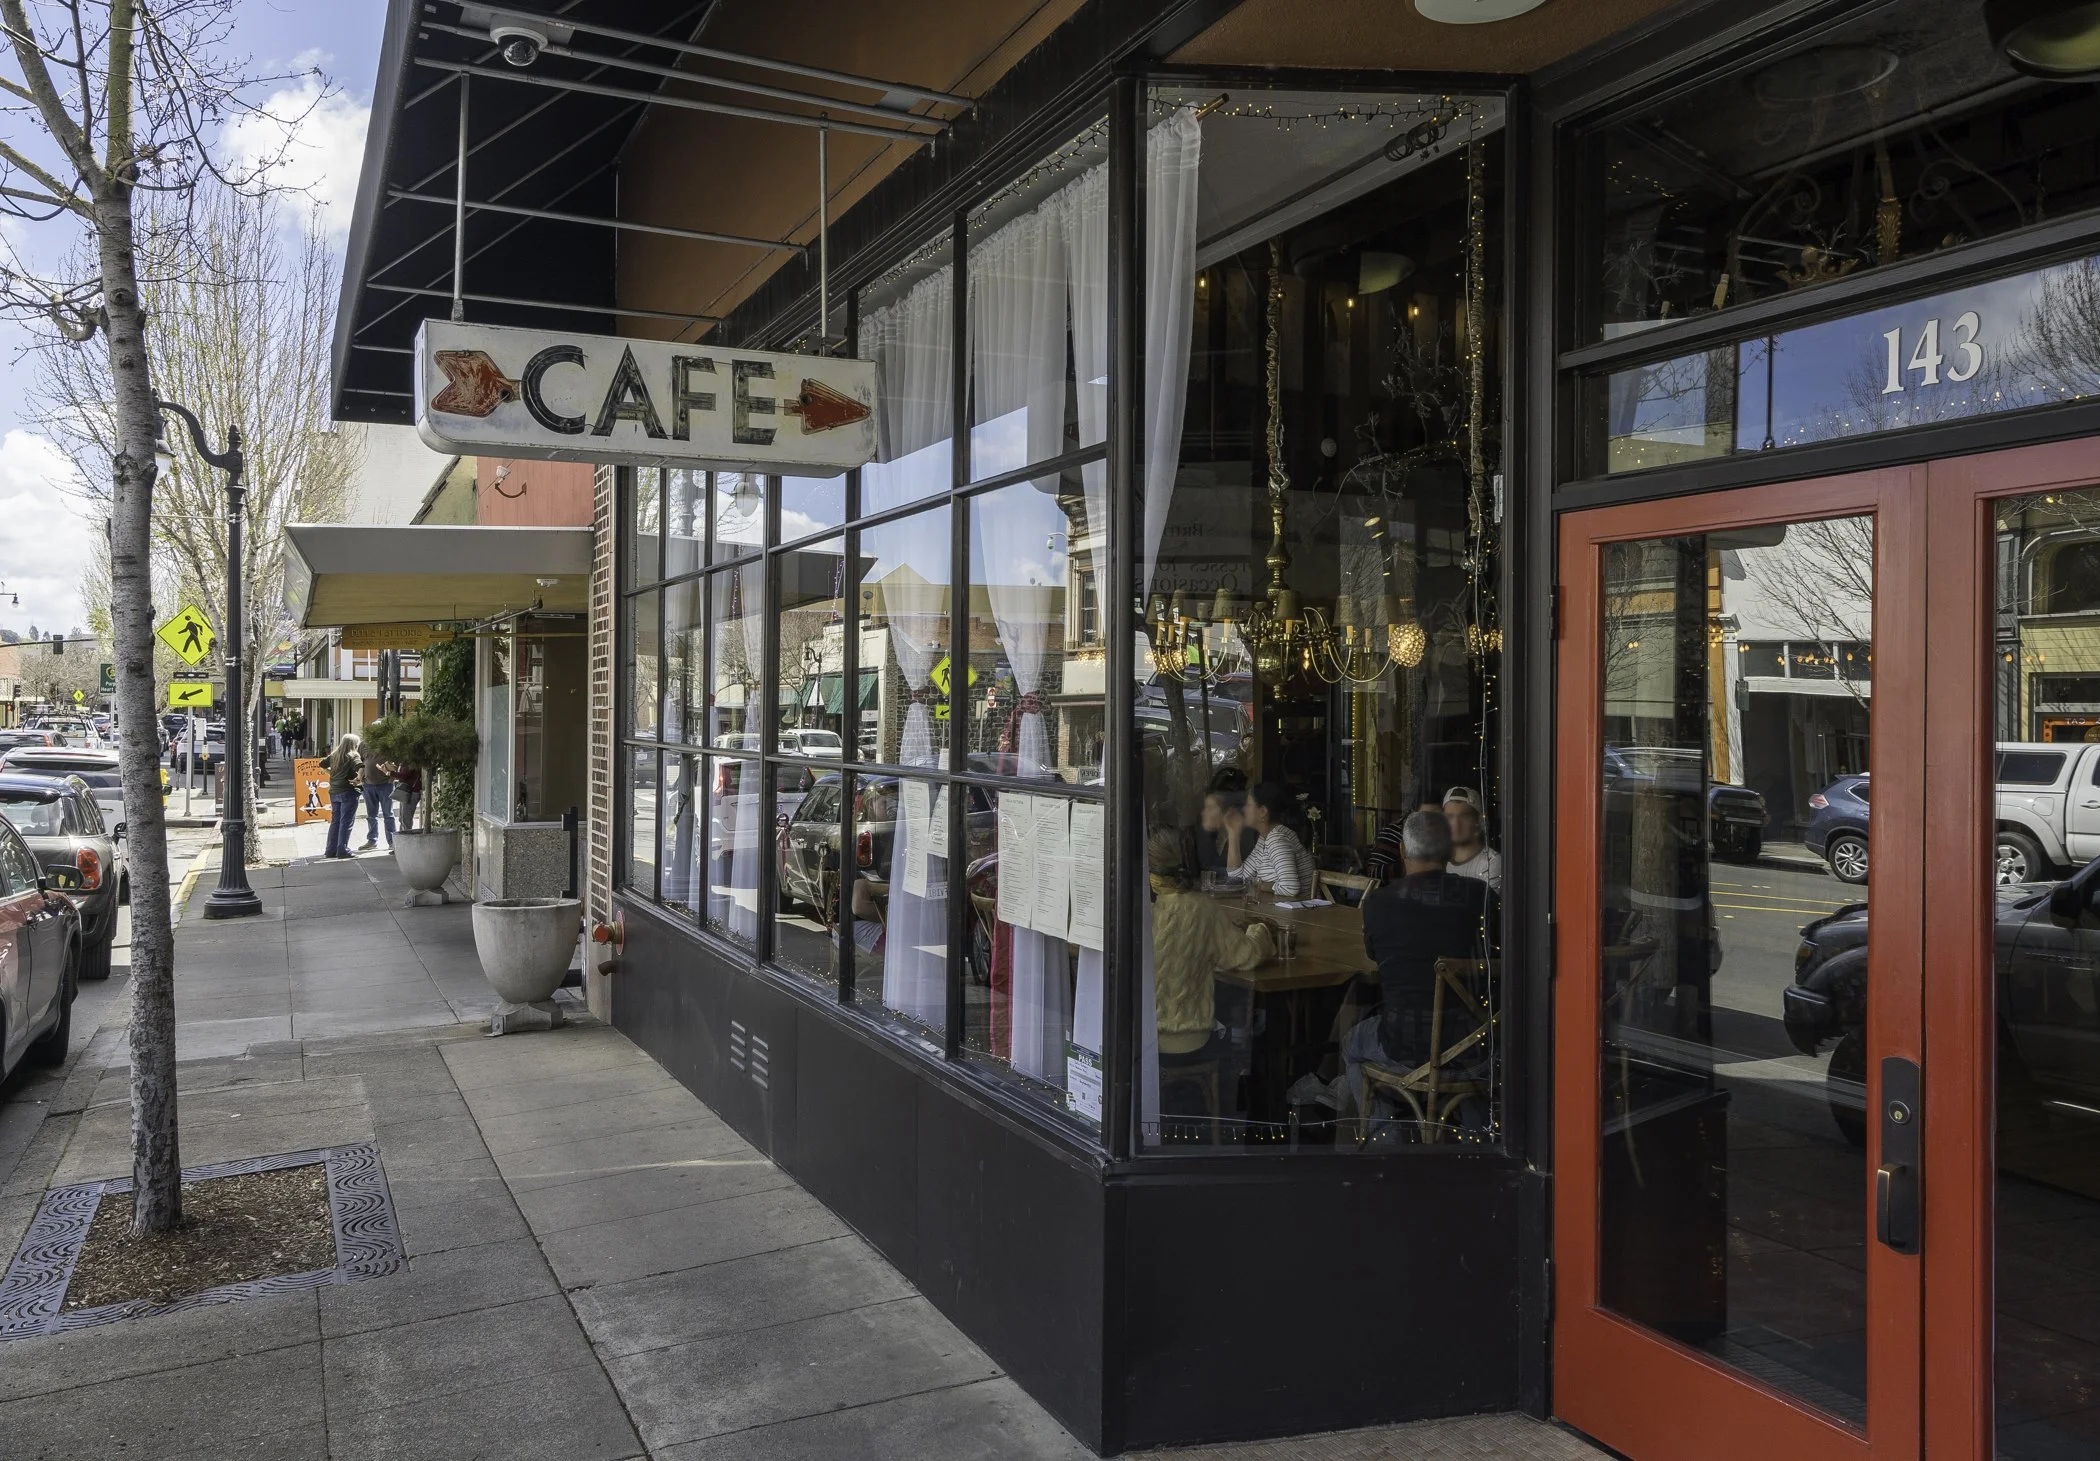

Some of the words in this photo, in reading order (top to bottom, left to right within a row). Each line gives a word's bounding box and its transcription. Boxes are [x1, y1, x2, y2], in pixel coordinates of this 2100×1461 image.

[1882, 311, 1982, 394] 143
[521, 343, 778, 446] CAFE
[1079, 1054, 1092, 1067] PASS
